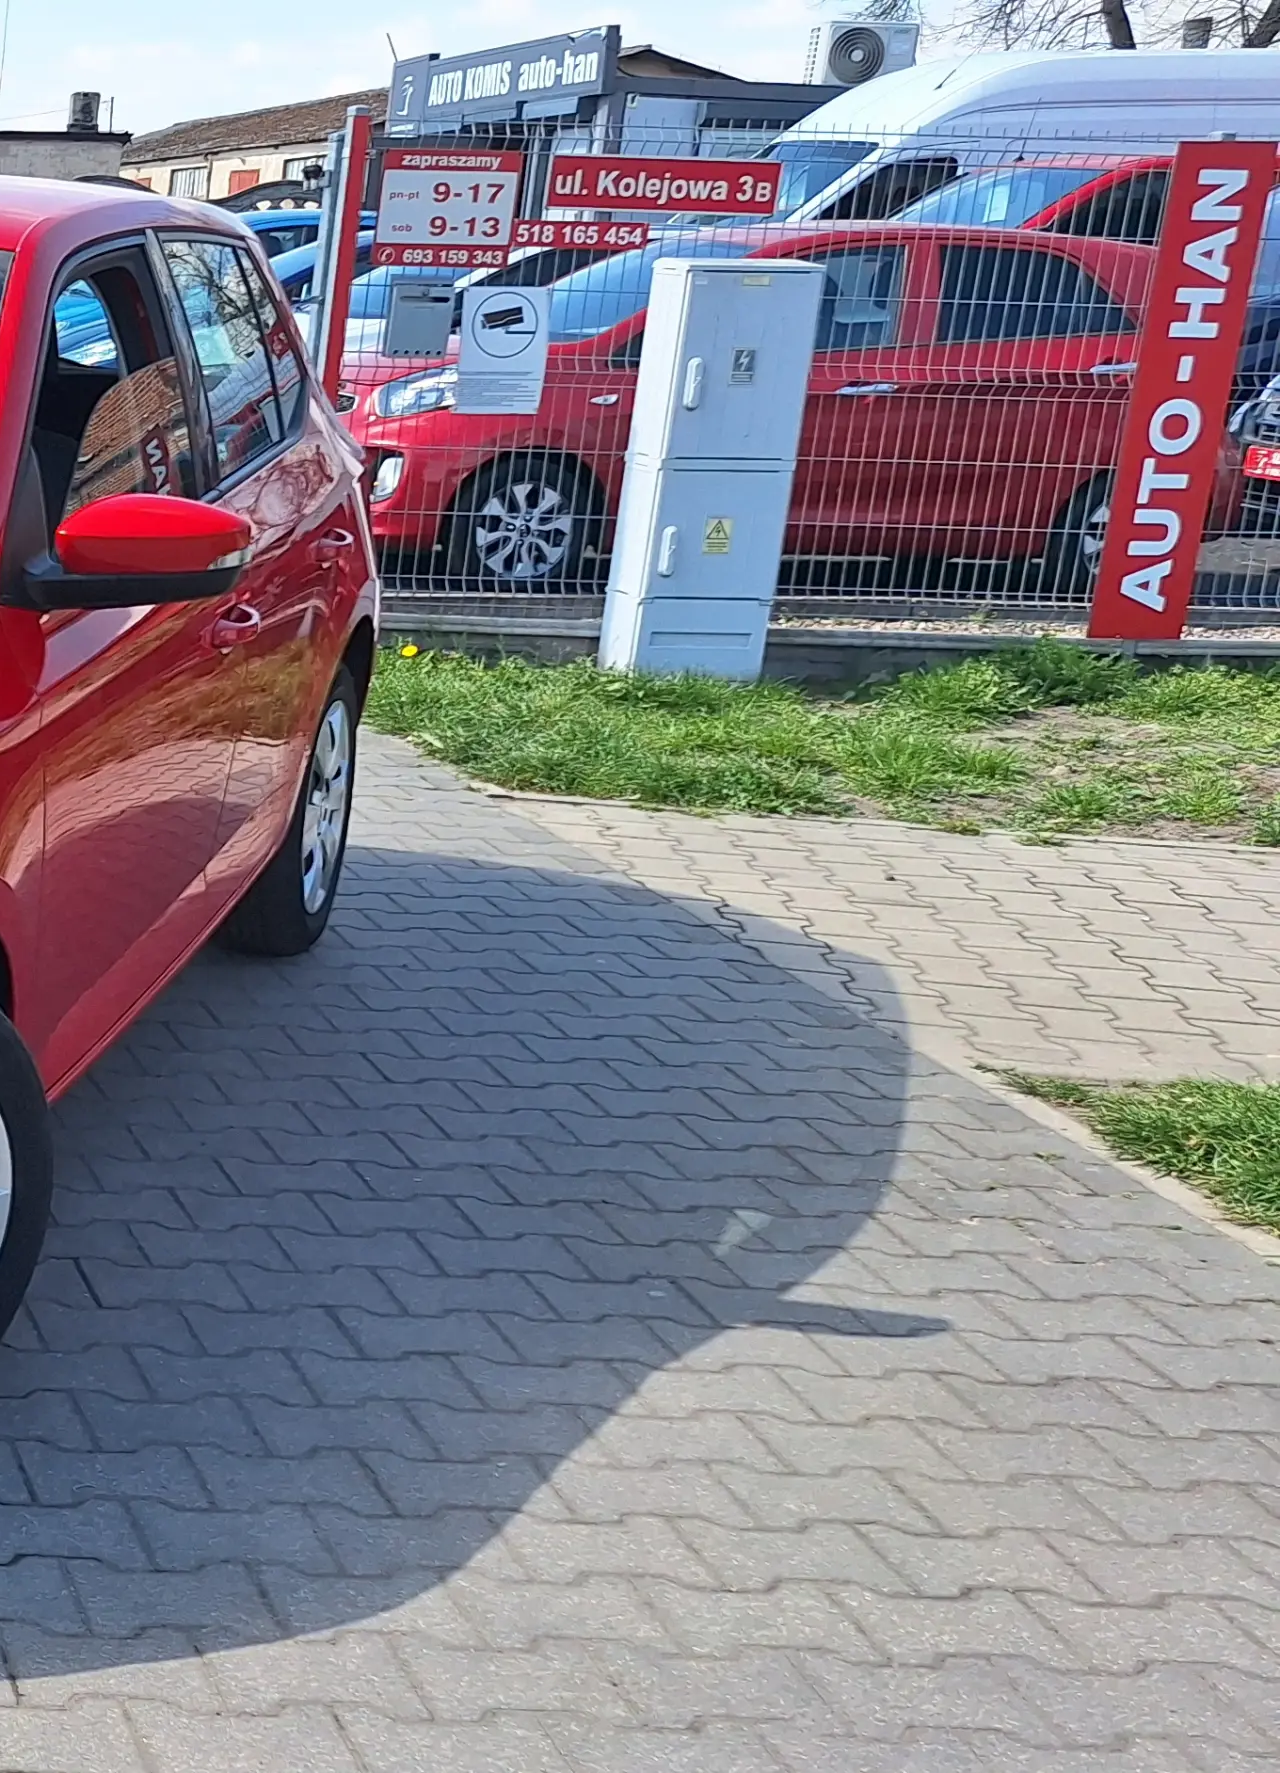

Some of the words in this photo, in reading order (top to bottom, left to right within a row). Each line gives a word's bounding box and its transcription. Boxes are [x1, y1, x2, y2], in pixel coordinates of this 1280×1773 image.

[428, 70, 462, 107] AUTO
[464, 60, 512, 101] KOMIS
[518, 49, 599, 92] auto-han
[401, 154, 502, 171] zapraszamy
[389, 190, 420, 201] pn-pt
[432, 182, 505, 204] 9-17
[555, 169, 589, 196] ul.
[596, 170, 729, 205] Kolejowa
[391, 222, 413, 233] sob
[428, 215, 501, 238] 9-13
[516, 224, 555, 244] 518
[561, 225, 599, 245] 165
[604, 226, 644, 246] 454
[402, 249, 434, 264] 693
[439, 250, 469, 265] 159
[472, 251, 504, 266] 343
